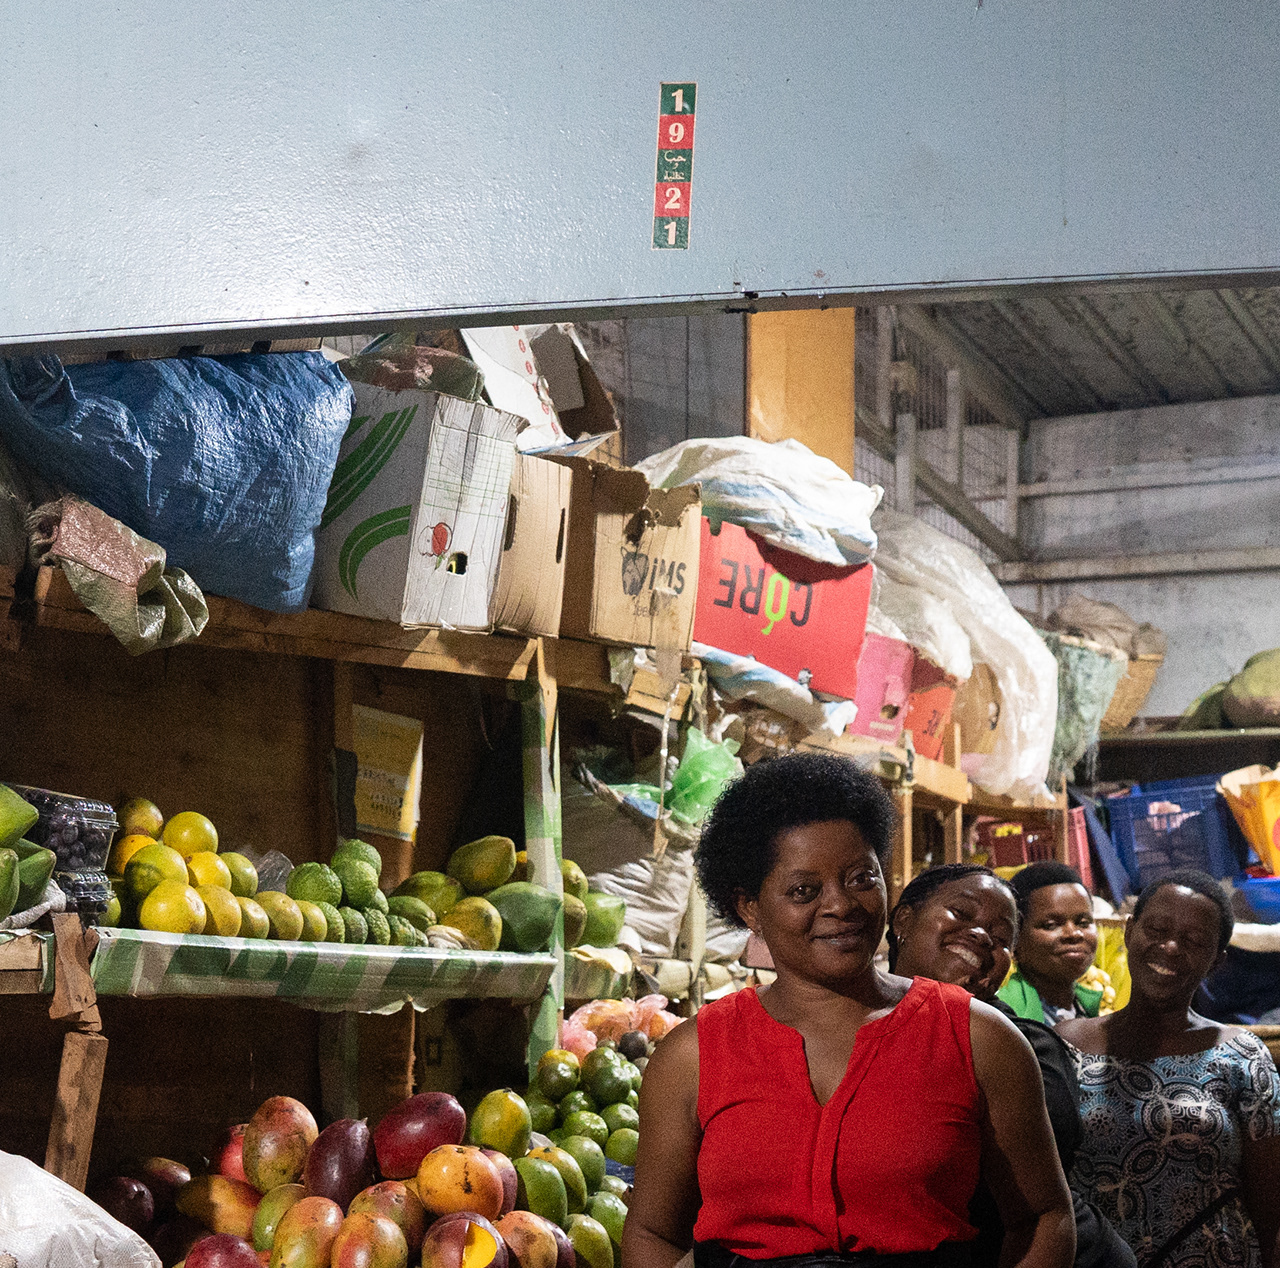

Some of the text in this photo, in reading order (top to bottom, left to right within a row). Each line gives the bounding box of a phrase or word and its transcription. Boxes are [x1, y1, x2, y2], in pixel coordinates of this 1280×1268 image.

[671, 88, 684, 112] 1
[668, 122, 685, 144] 9
[664, 187, 682, 209] 2
[663, 221, 677, 245] 1
[712, 558, 814, 636] CORE
